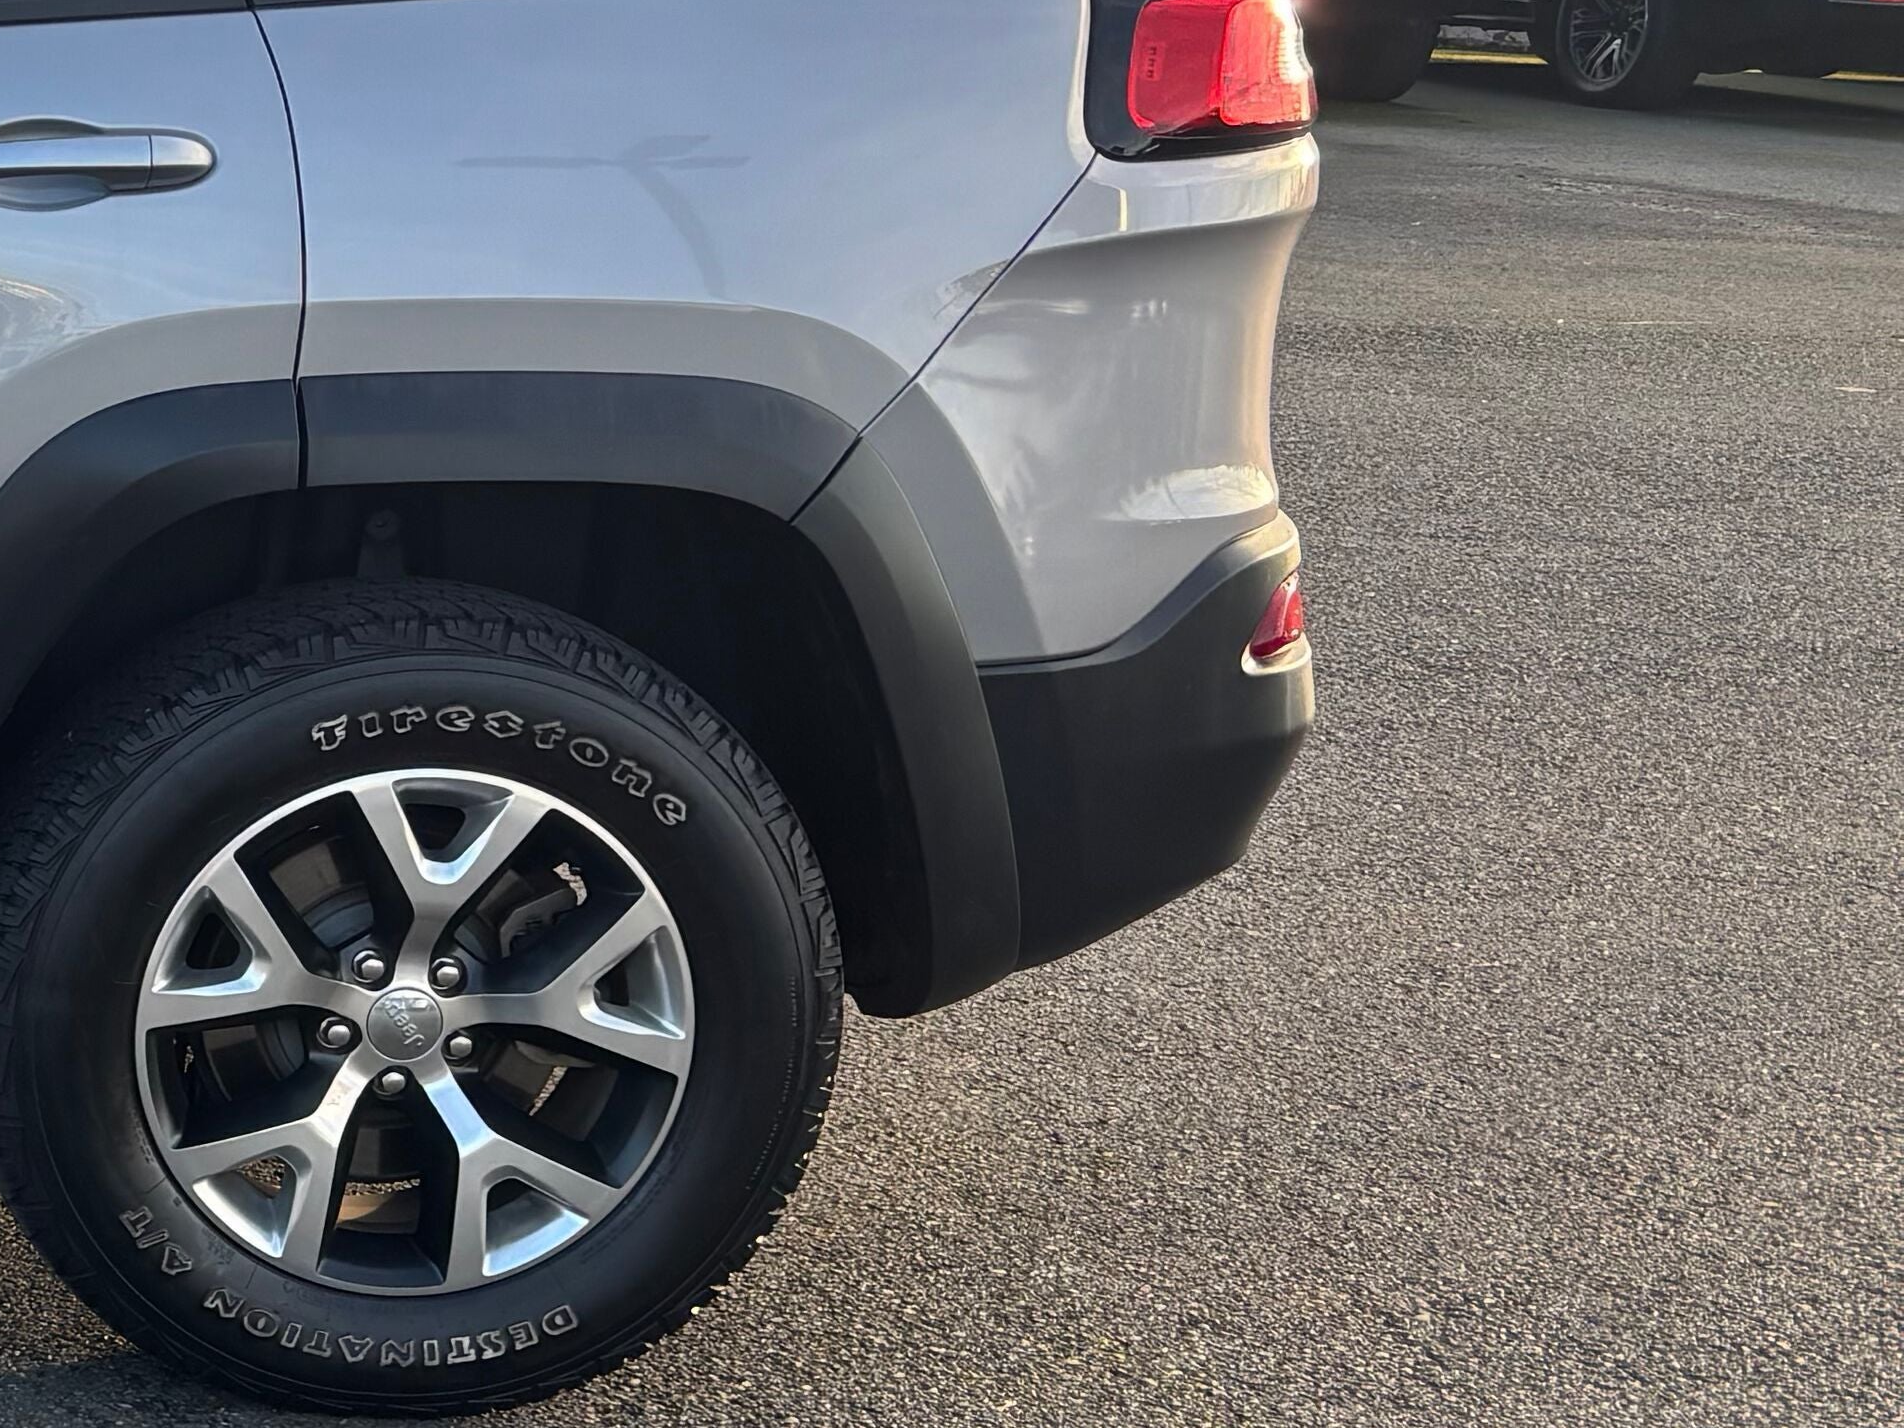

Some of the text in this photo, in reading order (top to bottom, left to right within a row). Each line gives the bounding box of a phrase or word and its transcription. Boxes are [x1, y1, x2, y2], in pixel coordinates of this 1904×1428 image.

[311, 705, 687, 826] Firestone
[118, 1206, 192, 1276] A/T
[203, 1285, 579, 1368] DESTINATION
